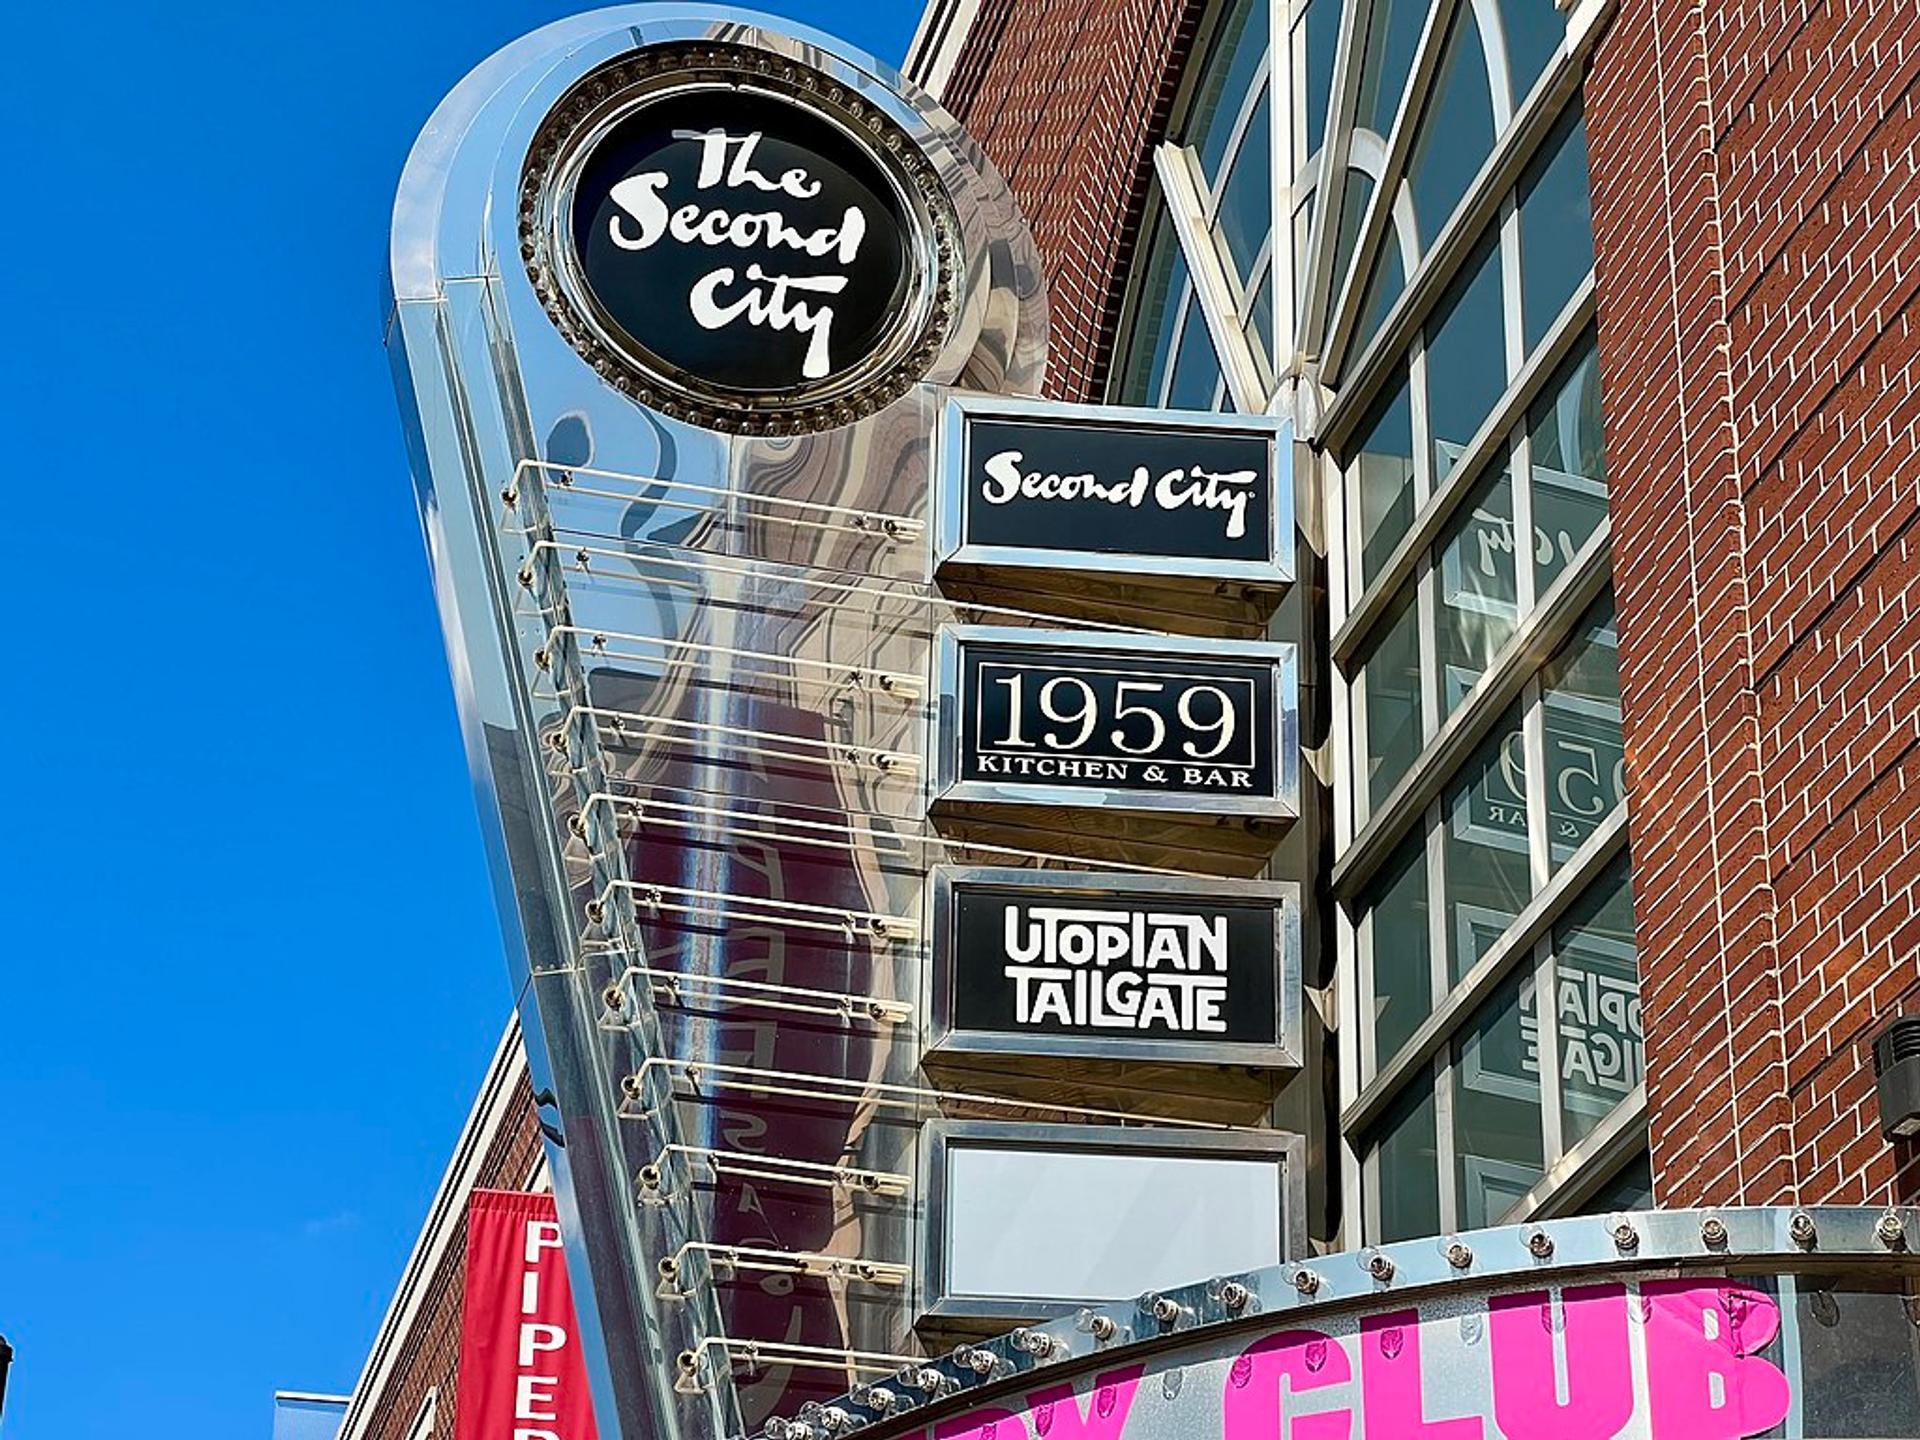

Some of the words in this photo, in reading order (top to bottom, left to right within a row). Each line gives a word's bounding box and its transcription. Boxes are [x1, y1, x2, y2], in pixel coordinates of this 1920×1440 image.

[672, 128, 822, 198] The
[609, 171, 866, 264] Second
[689, 263, 849, 379] City
[982, 451, 1150, 509] Second
[994, 673, 1236, 760] 1959
[977, 755, 1129, 781] KITCHEN
[1142, 765, 1169, 784] &
[1183, 768, 1254, 788] BAR
[1004, 904, 1228, 971] UTOPIAN
[1004, 965, 1228, 1033] TAILGATE
[513, 1220, 568, 1440] PIPE
[1223, 1277, 1791, 1440] CLUB
